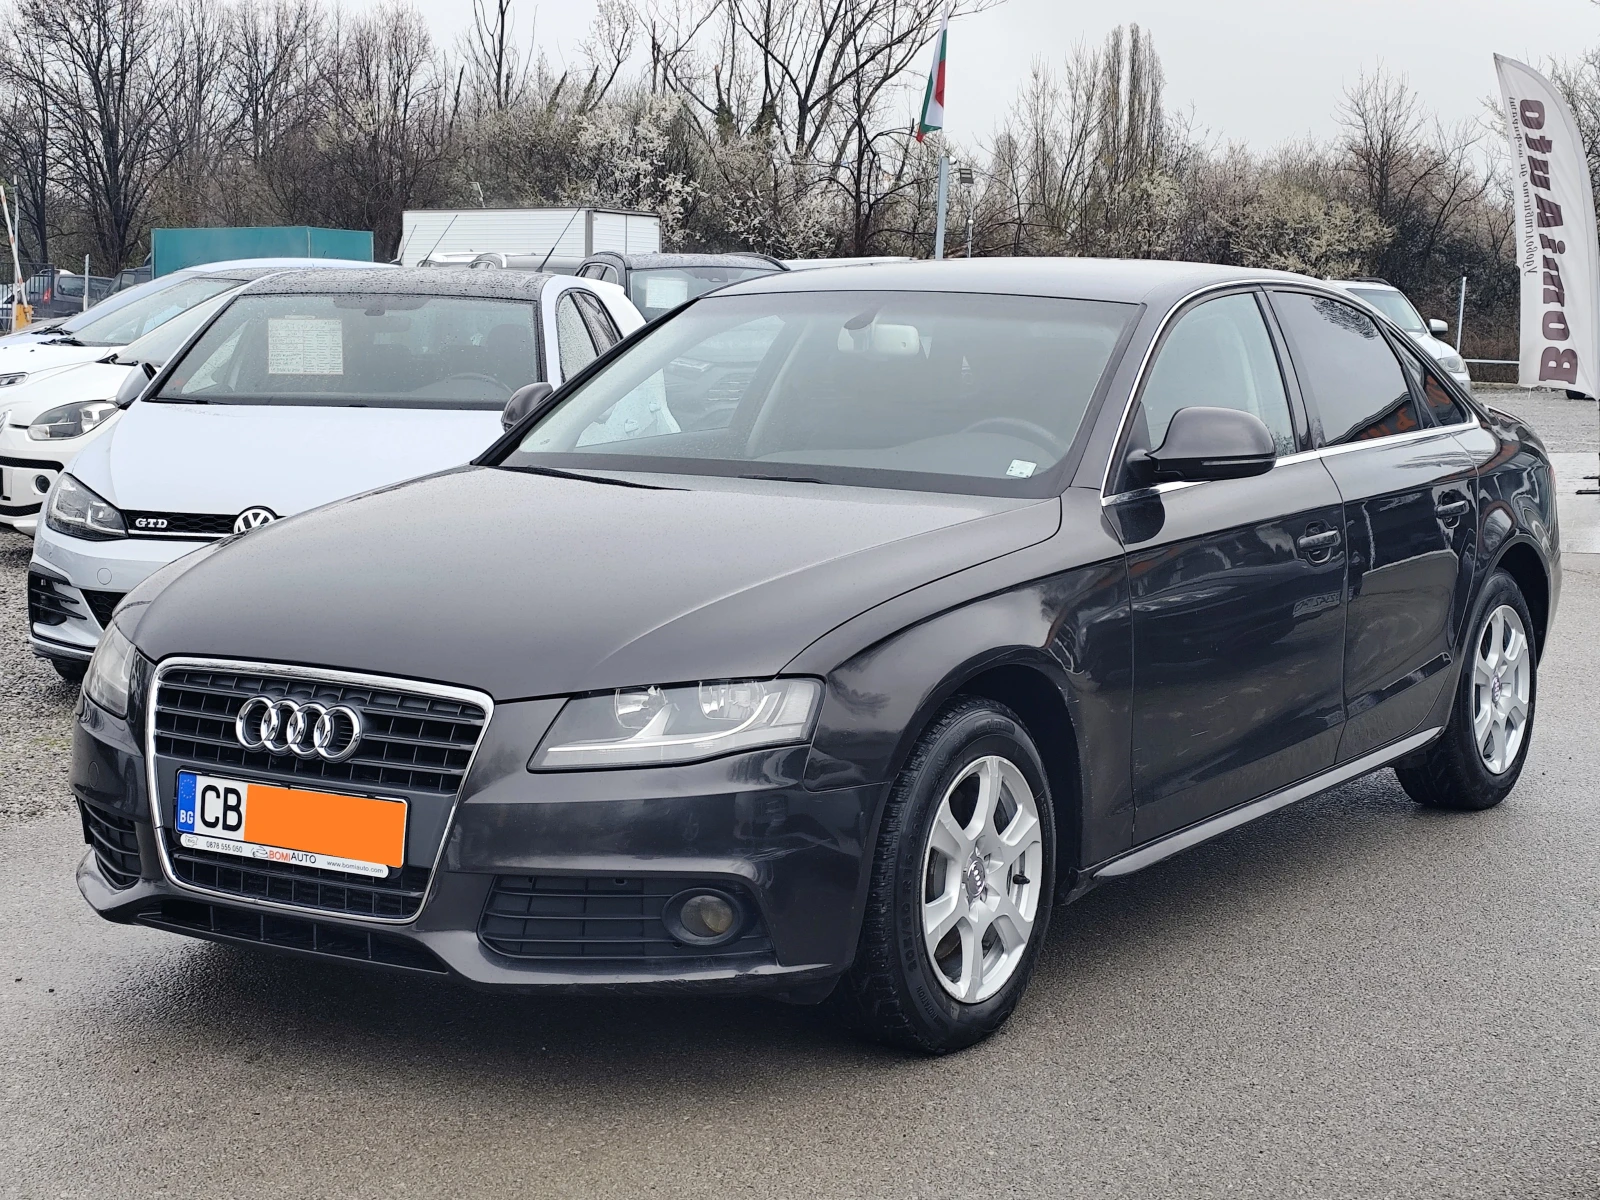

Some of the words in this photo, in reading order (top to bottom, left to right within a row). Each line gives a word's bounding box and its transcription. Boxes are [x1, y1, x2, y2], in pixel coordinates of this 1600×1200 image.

[135, 517, 168, 529] GTD
[200, 784, 243, 832] CB
[179, 809, 194, 824] BG
[206, 840, 220, 850] 0878
[221, 842, 232, 851] 555
[268, 849, 317, 864] BOMIAUTO
[326, 859, 384, 874] www.bomiauto.com
[916, 984, 939, 1020] ROTATION
